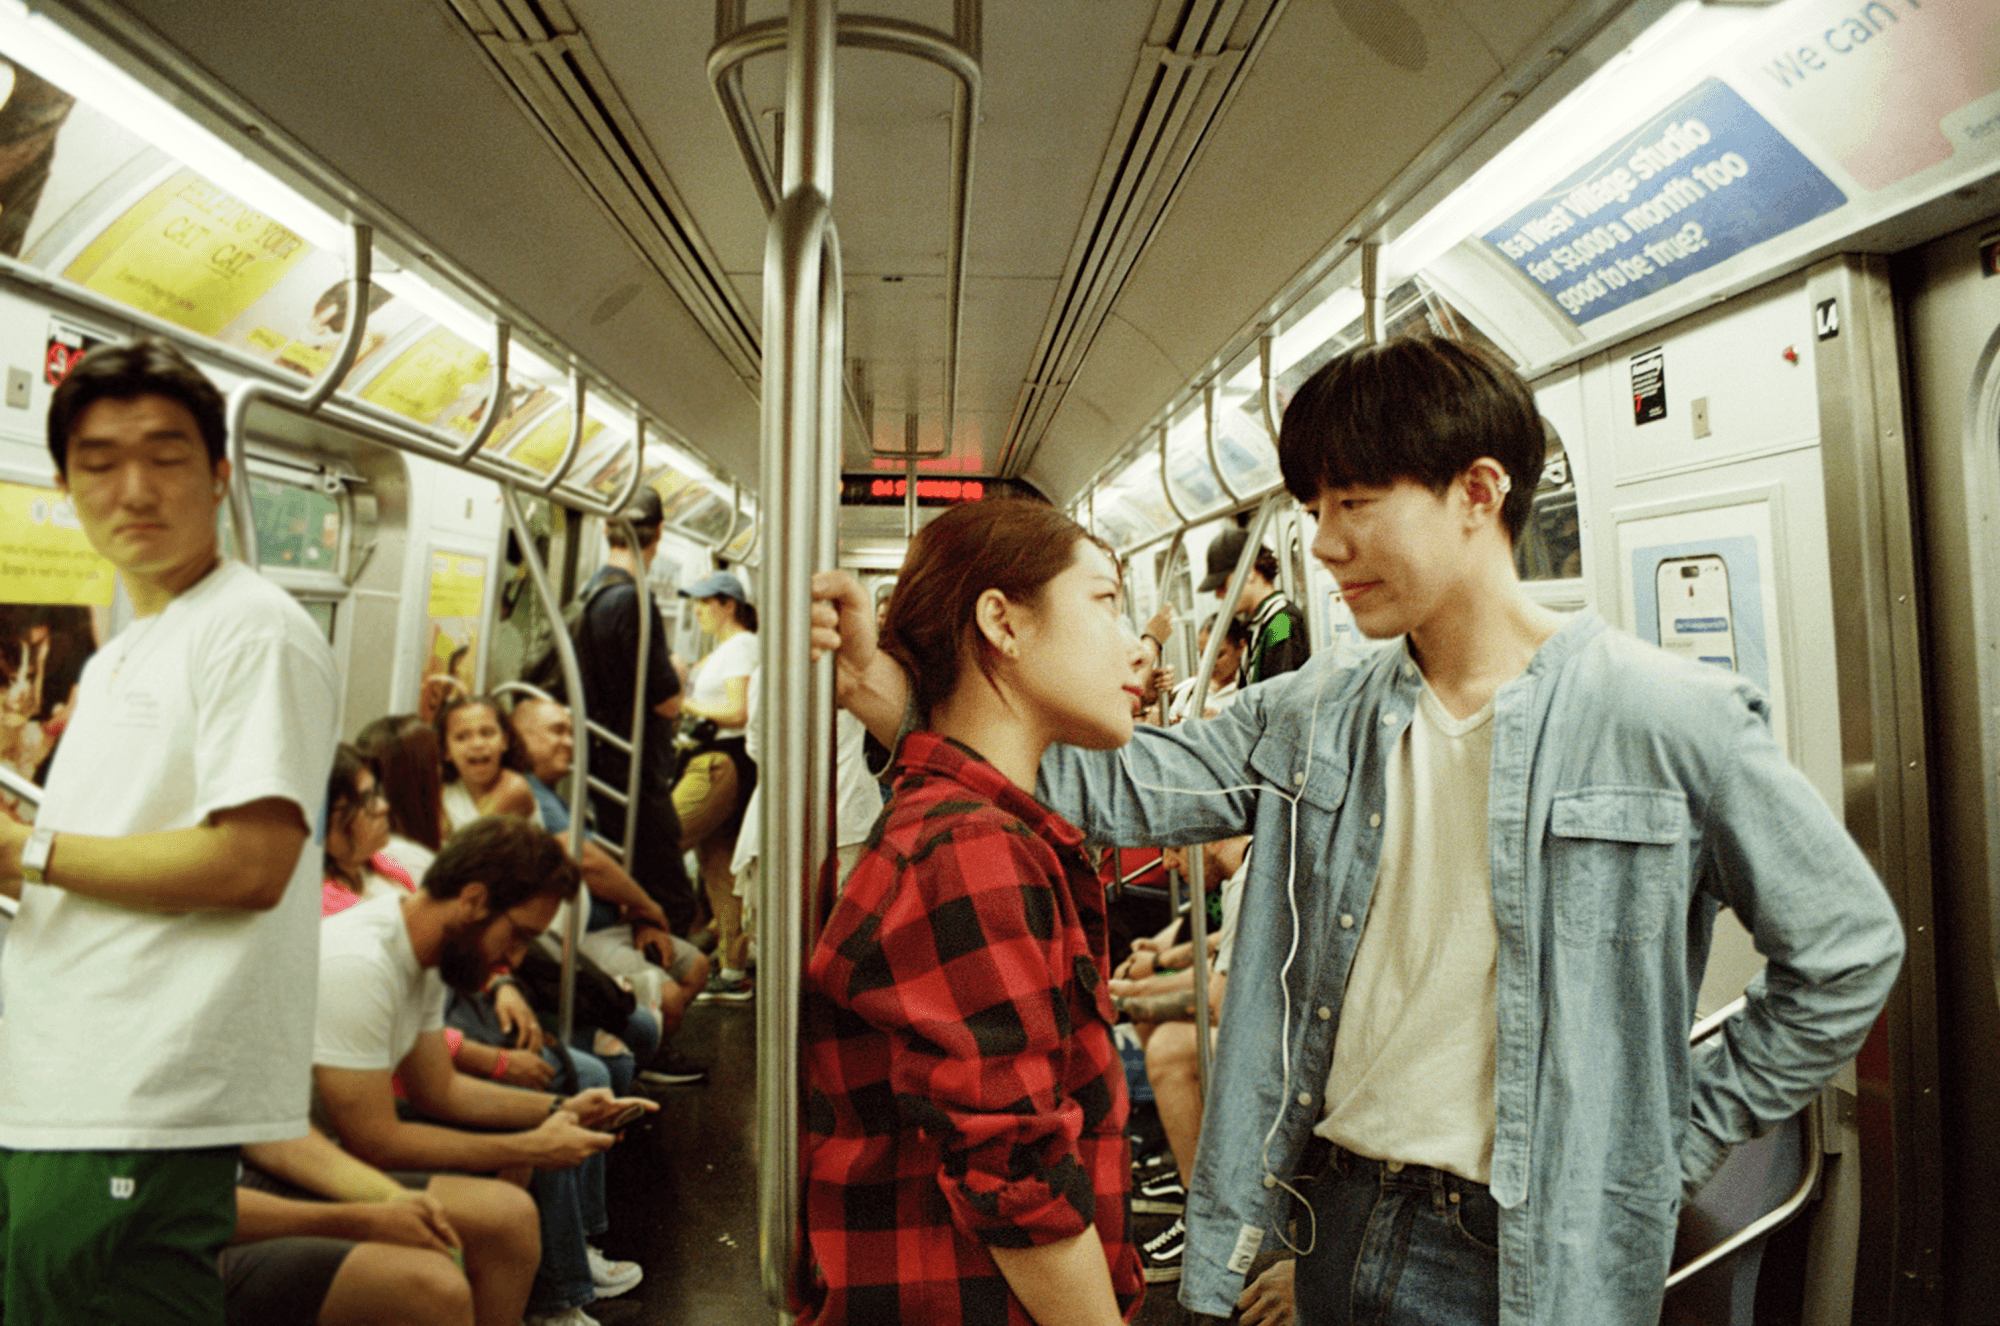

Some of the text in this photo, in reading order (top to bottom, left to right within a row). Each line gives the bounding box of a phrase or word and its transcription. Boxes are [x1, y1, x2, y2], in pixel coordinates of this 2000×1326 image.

[1762, 1, 1898, 89] We can
[1628, 119, 1711, 180] studio
[1527, 256, 1563, 284] for
[1607, 221, 1632, 243] a
[1621, 177, 1707, 233] month
[1691, 152, 1749, 192] too
[1560, 167, 1638, 218] Village
[1514, 233, 1536, 252] a
[1520, 204, 1576, 245] West
[1556, 221, 1709, 315] good to be true?
